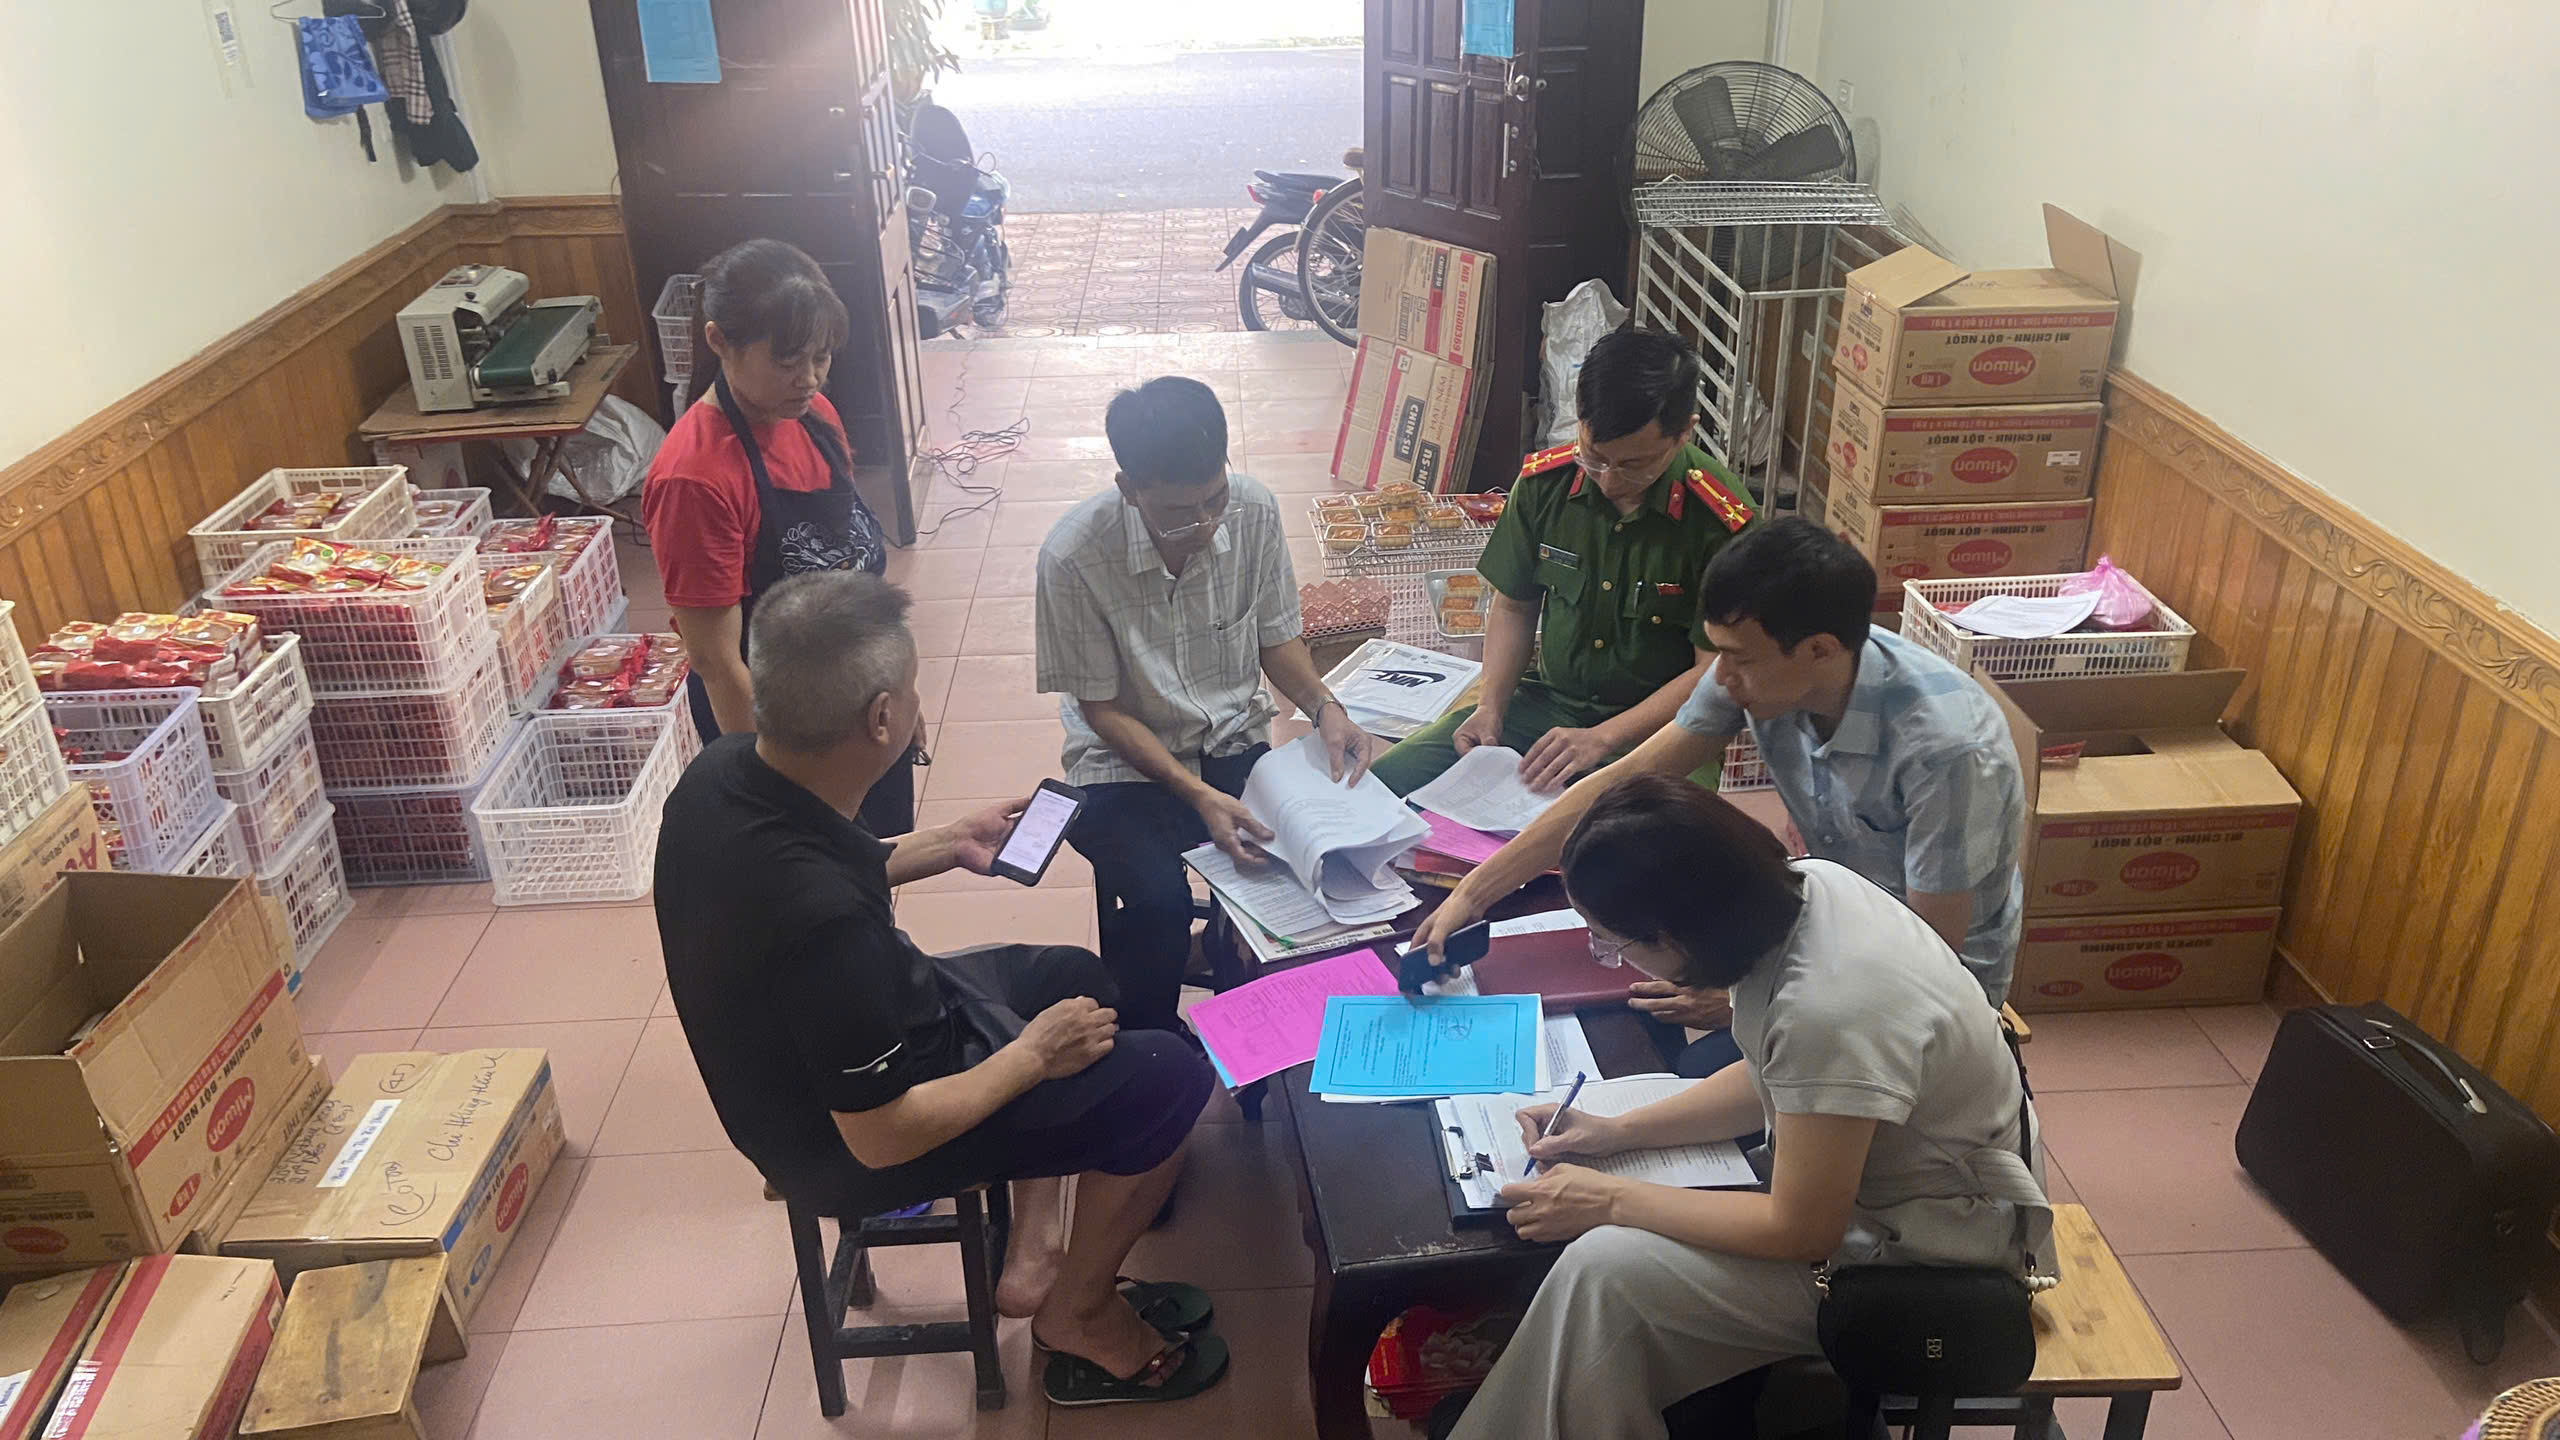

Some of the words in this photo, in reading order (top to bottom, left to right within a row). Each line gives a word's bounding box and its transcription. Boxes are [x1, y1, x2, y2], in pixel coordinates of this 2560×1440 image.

[1972, 357, 2034, 375] Miwon
[1401, 403, 1419, 455] CHIN-SU
[1954, 458, 2014, 474] Miwon
[1951, 549, 2010, 564] Miwon
[1369, 670, 1429, 688] NIKE
[2108, 964, 2180, 980] Miwon
[200, 1080, 218, 1110] BỘT
[208, 1082, 253, 1145] Miwon
[172, 1104, 199, 1142] NGỌT
